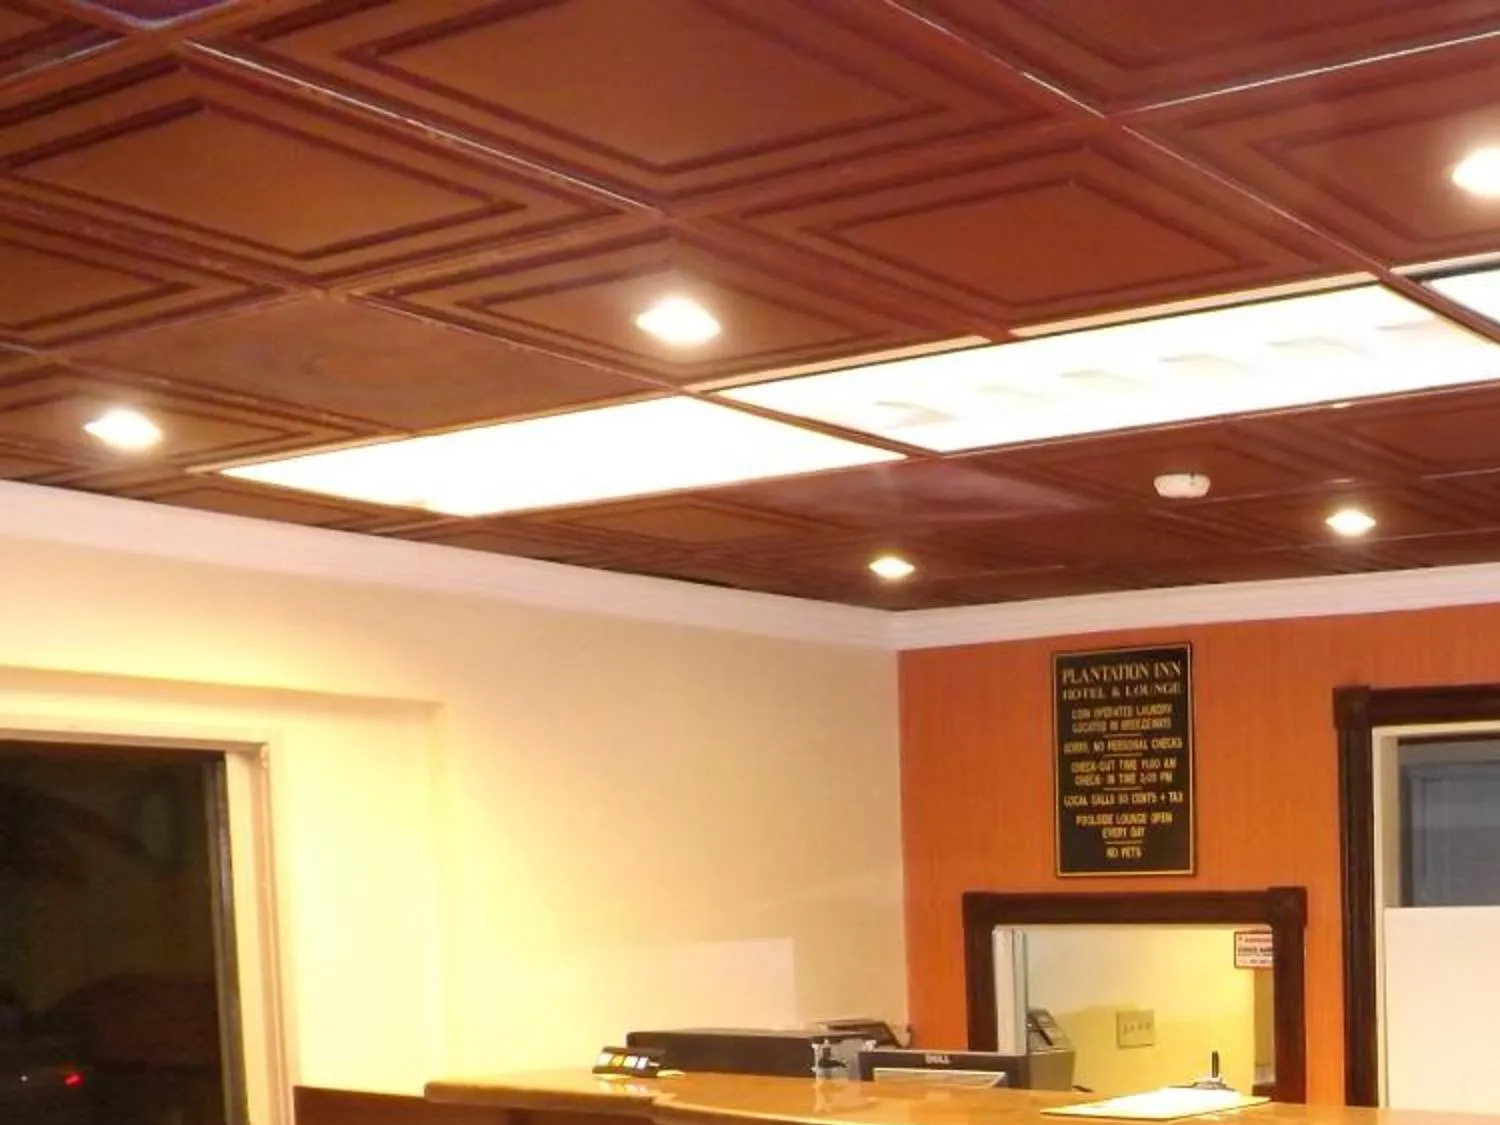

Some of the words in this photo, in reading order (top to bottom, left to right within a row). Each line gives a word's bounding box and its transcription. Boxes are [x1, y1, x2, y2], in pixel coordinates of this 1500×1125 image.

[1063, 664, 1149, 684] PLANTATION
[1152, 660, 1182, 679] INN
[1062, 687, 1106, 700] HOTEL
[1125, 682, 1182, 697] LOUNGE
[1135, 703, 1172, 716] LAUNDRY
[1151, 736, 1183, 749] CHECKS
[1063, 795, 1088, 807] LOCAL
